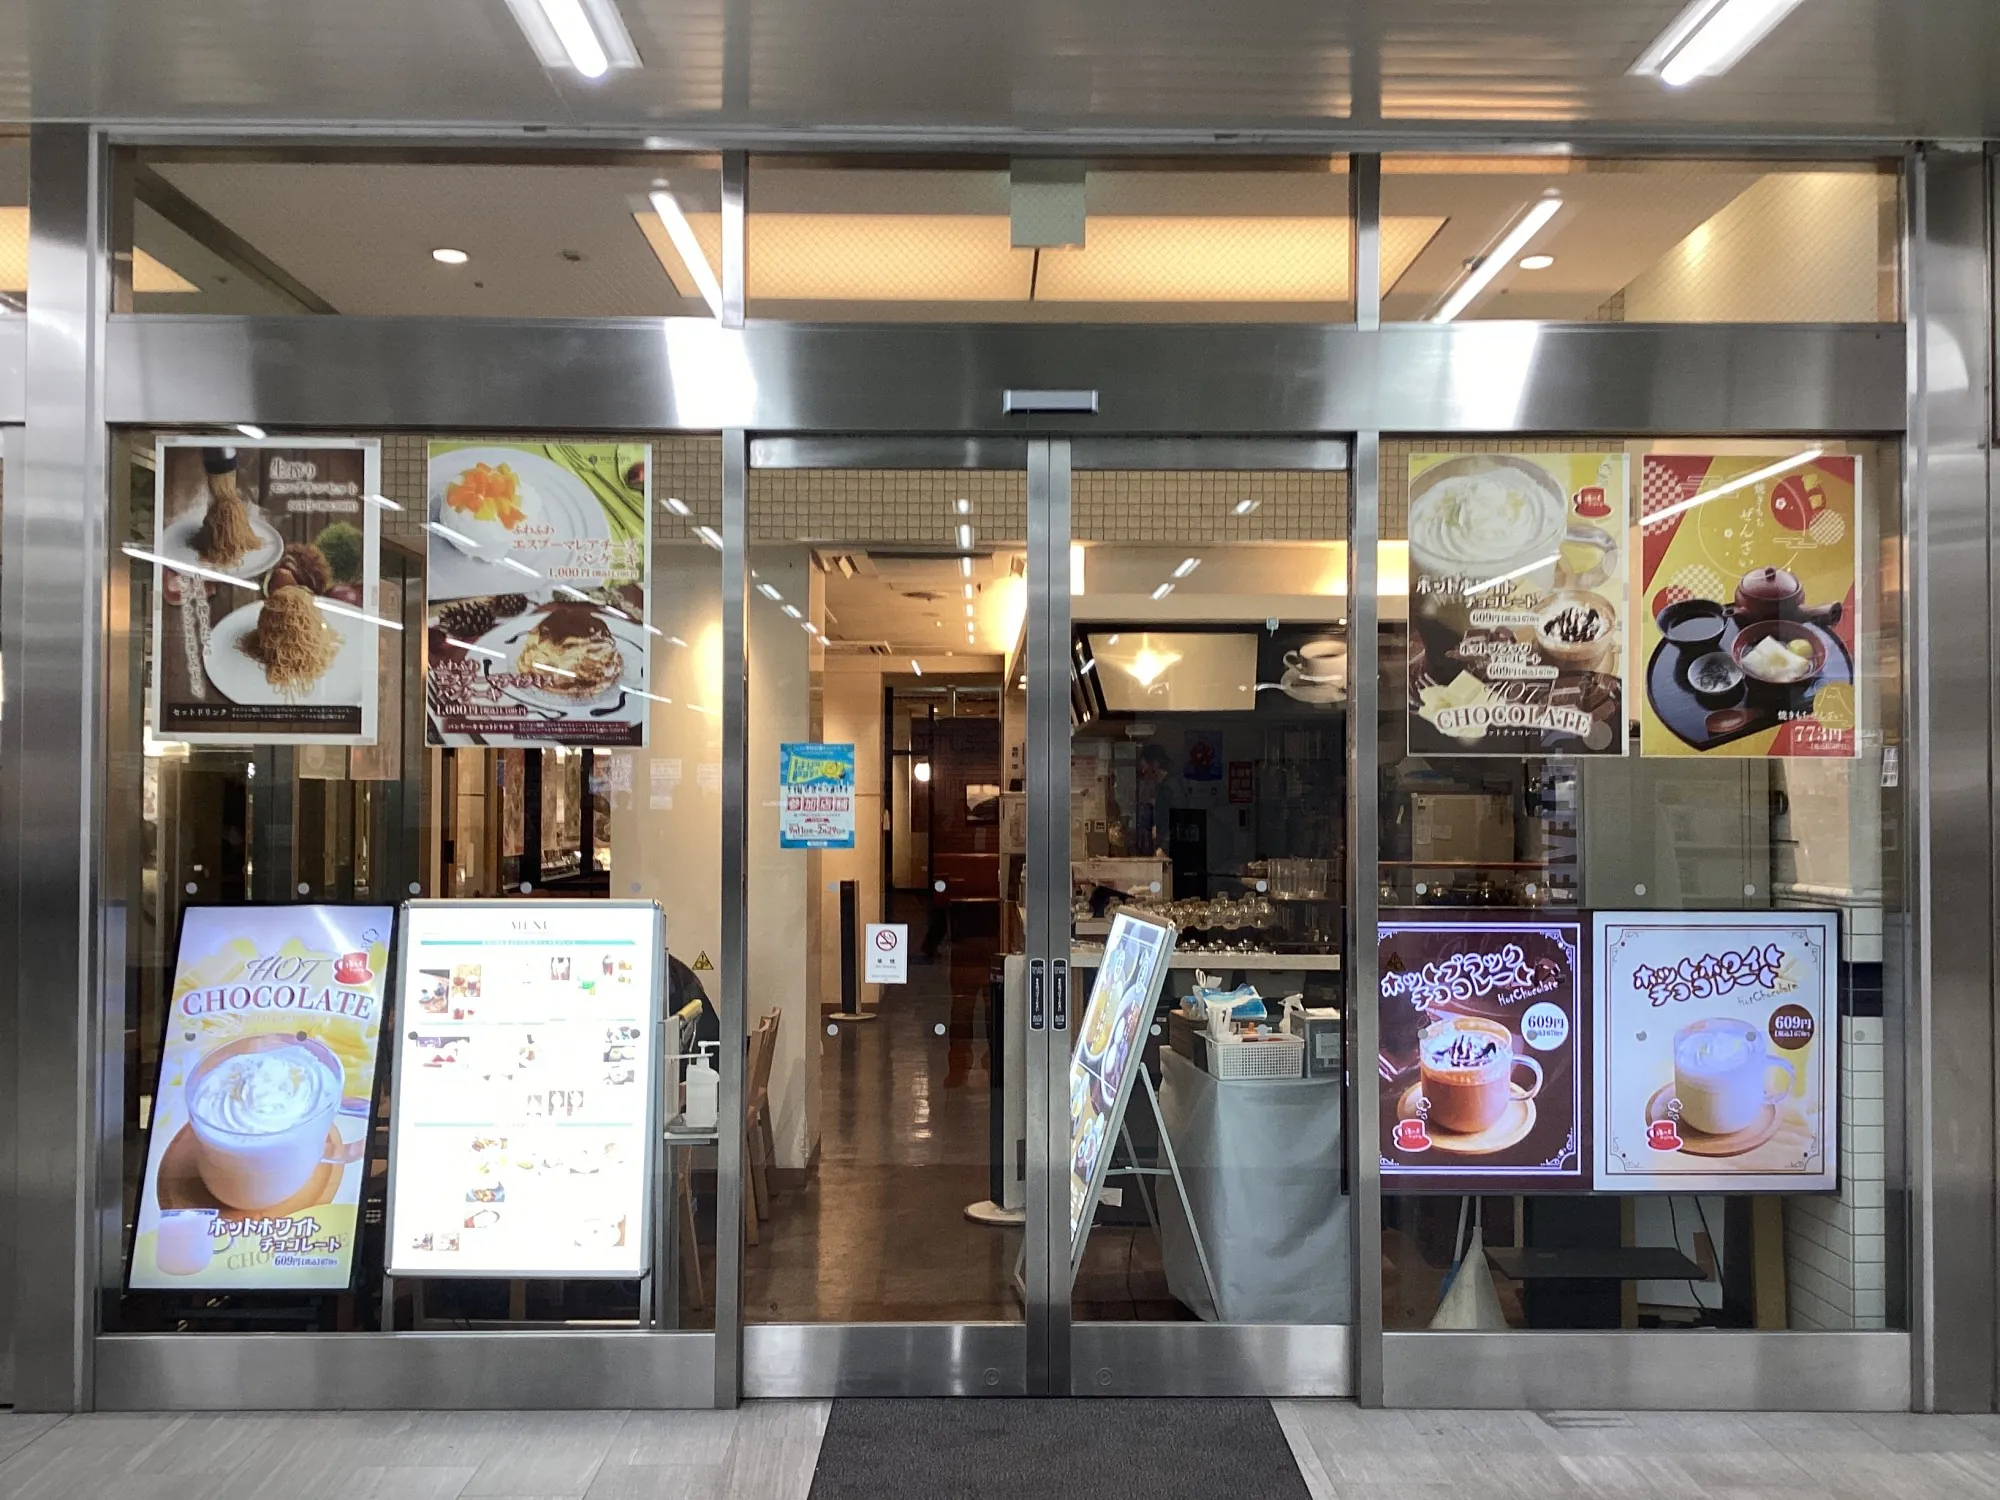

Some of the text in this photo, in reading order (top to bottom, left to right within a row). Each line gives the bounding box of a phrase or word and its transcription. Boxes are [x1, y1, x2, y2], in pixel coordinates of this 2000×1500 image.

[512, 525, 555, 535] ふわふわ
[1484, 679, 1549, 704] HOT
[173, 707, 228, 717] セットドリンク
[1437, 705, 1591, 735] CHOCOLATE
[1795, 725, 1842, 743] 773円
[246, 955, 333, 984] HOT
[1381, 943, 1525, 998] ホットブラック
[1632, 943, 1785, 990] ホットホワイト
[1411, 962, 1536, 1011] チョコレート
[1648, 965, 1780, 1007] チョコレート
[182, 985, 375, 1020] CHOCOLATE
[1528, 1014, 1565, 1029] 609円
[1774, 1015, 1812, 1030] 609円
[208, 1217, 321, 1237] ホットホワイト
[260, 1237, 341, 1253] チョコレート
